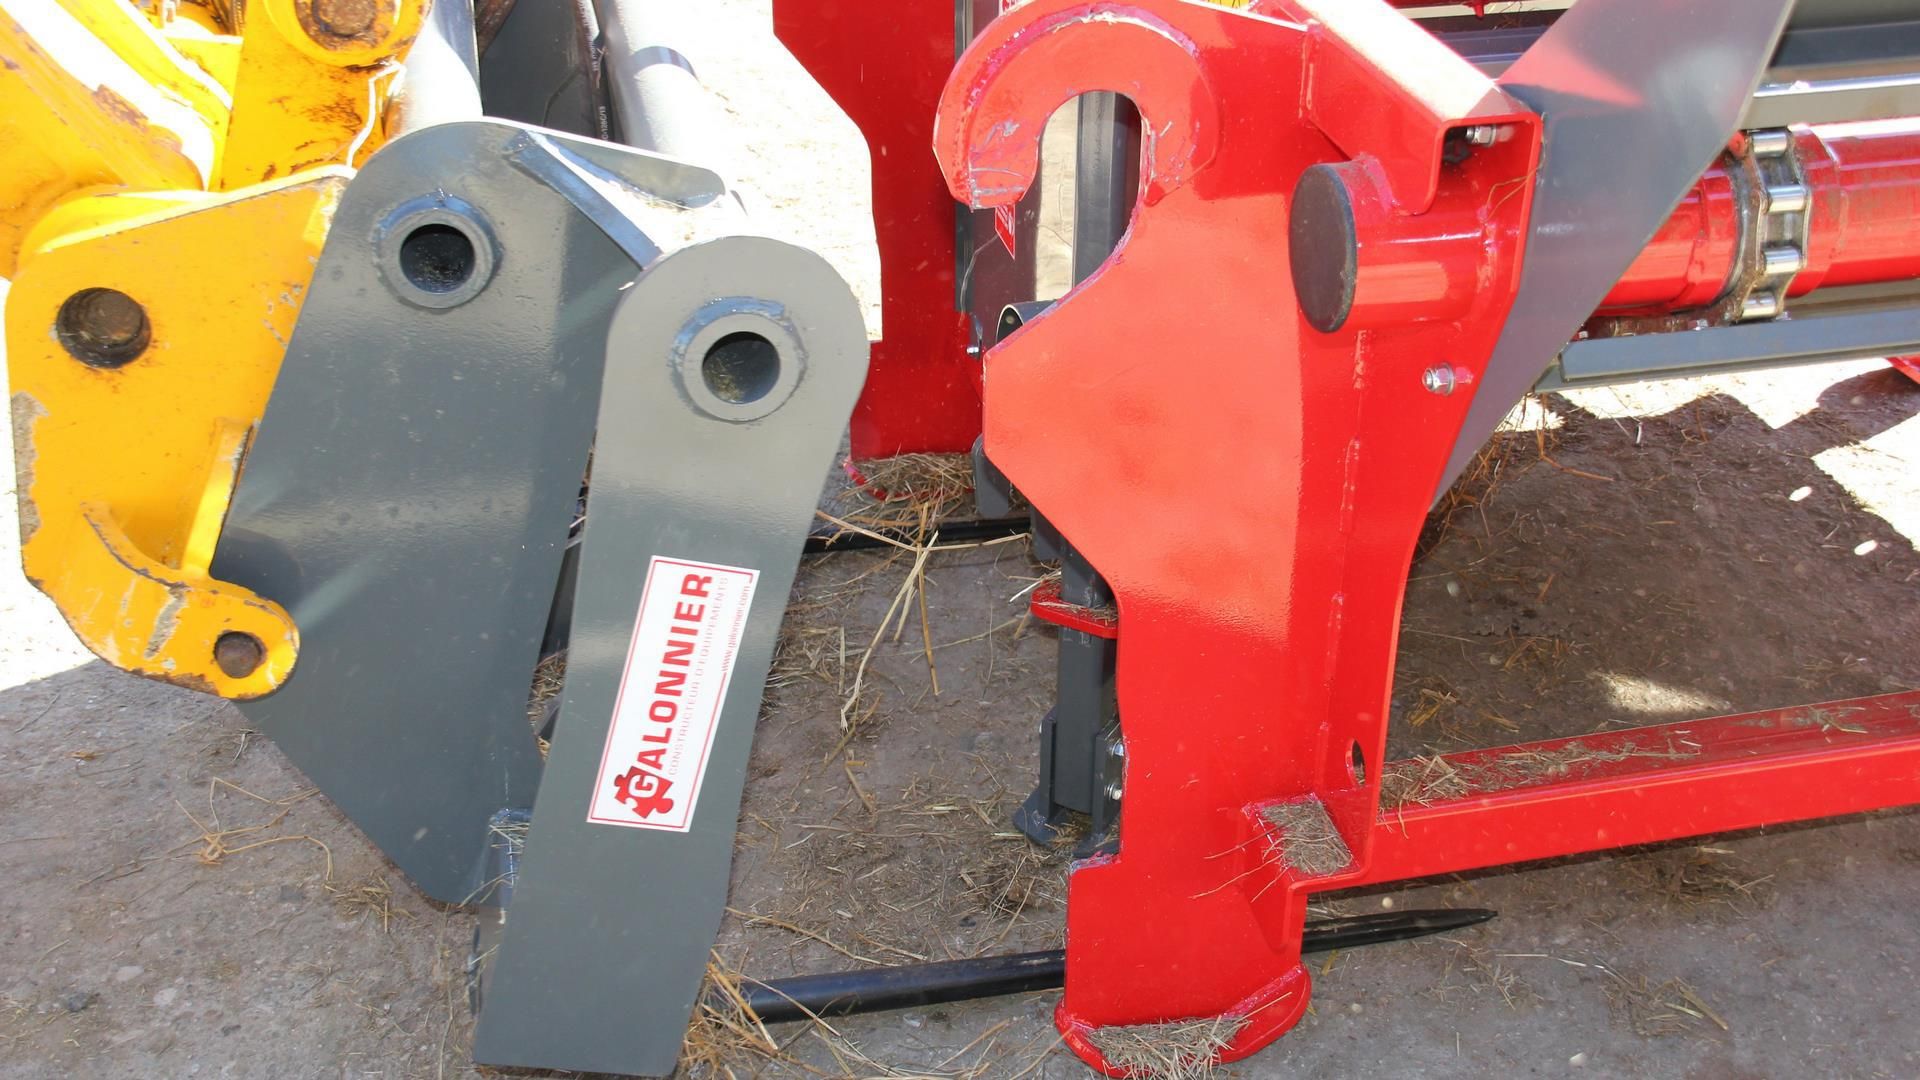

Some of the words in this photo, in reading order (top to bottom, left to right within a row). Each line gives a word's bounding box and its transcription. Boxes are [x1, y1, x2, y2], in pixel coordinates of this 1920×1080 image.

[721, 585, 751, 672] www.galonnier.com
[628, 573, 713, 799] GALONNIER
[668, 681, 701, 776] CONSTRUCTEUR
